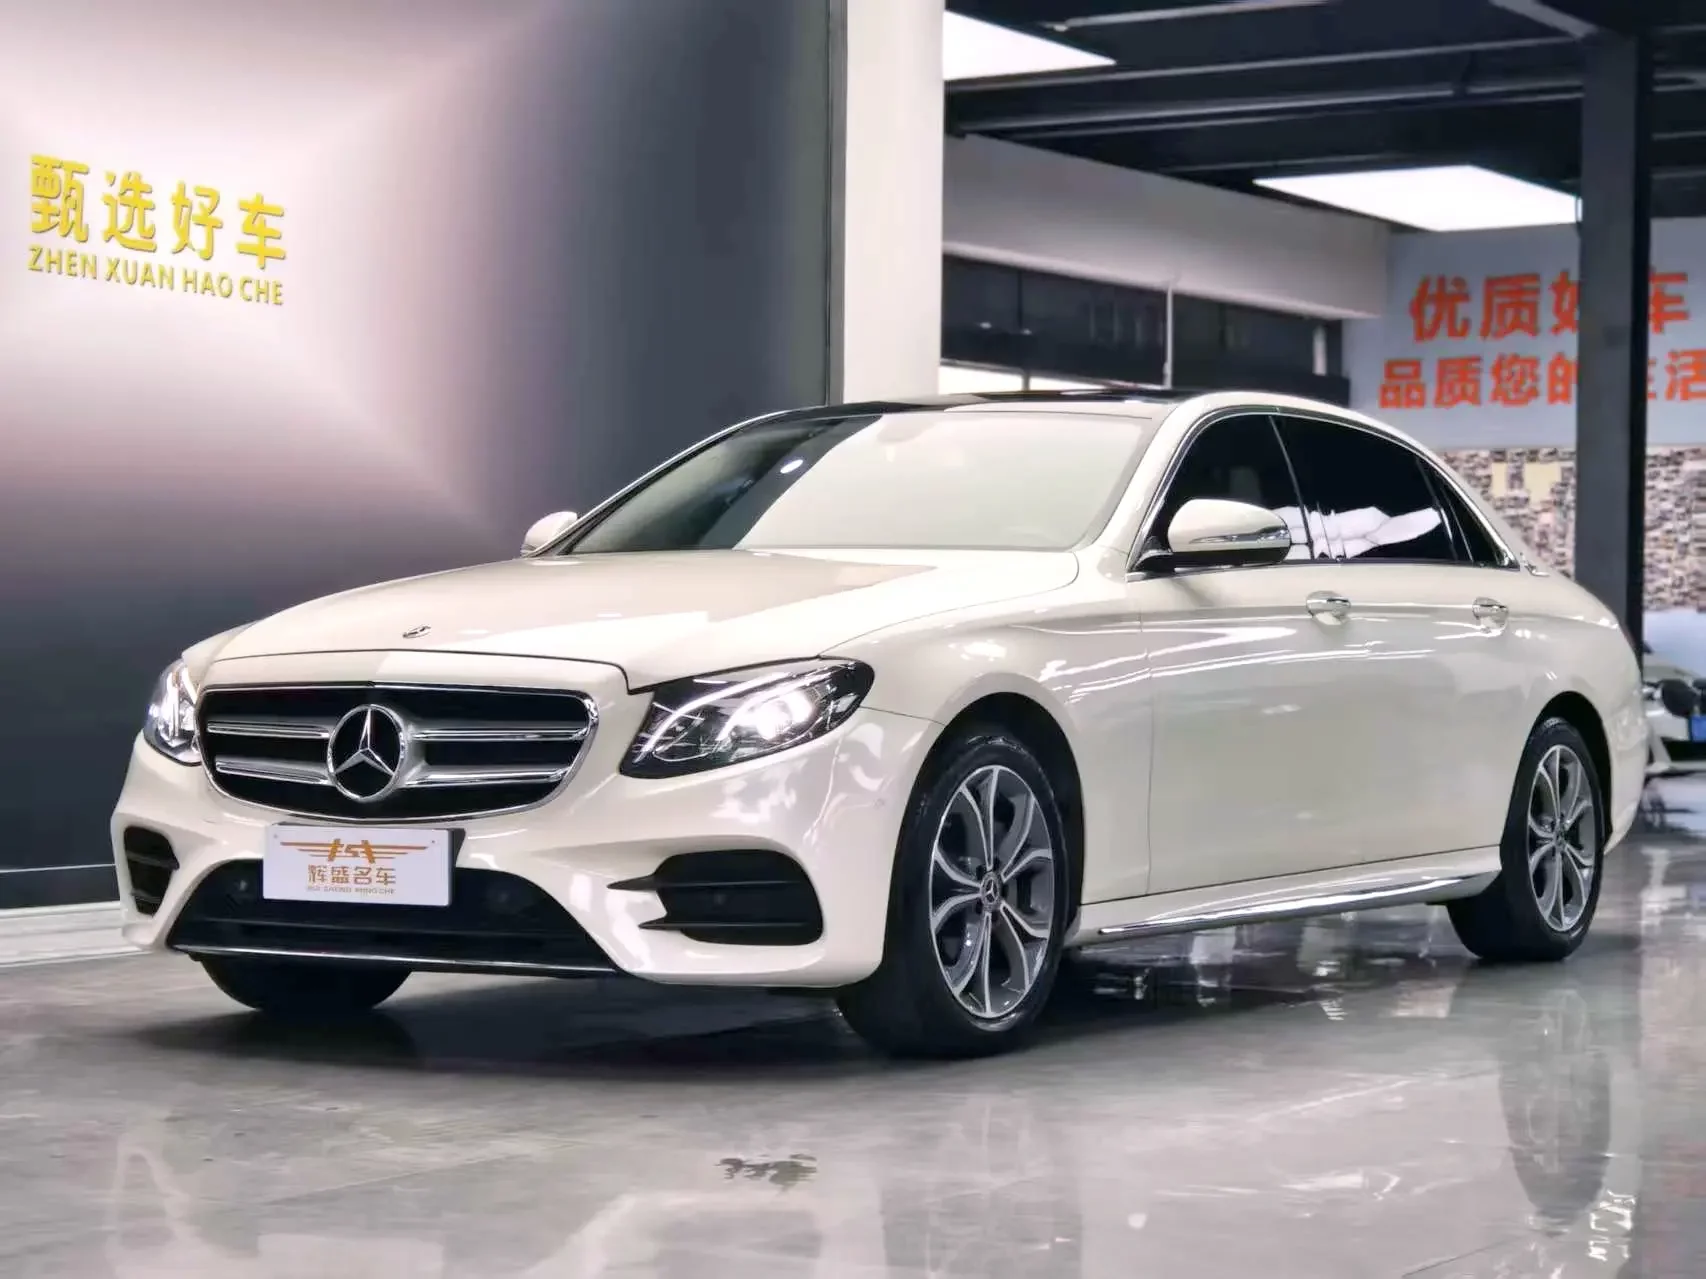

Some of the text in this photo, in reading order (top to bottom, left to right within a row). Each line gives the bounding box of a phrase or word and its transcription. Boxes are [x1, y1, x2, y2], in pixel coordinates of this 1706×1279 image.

[30, 155, 286, 269] 甄选好车
[28, 244, 284, 306] ZHEN XUAN HAO CHE
[1379, 349, 1706, 408] 品质您的活
[307, 865, 397, 886] 辉盛名车
